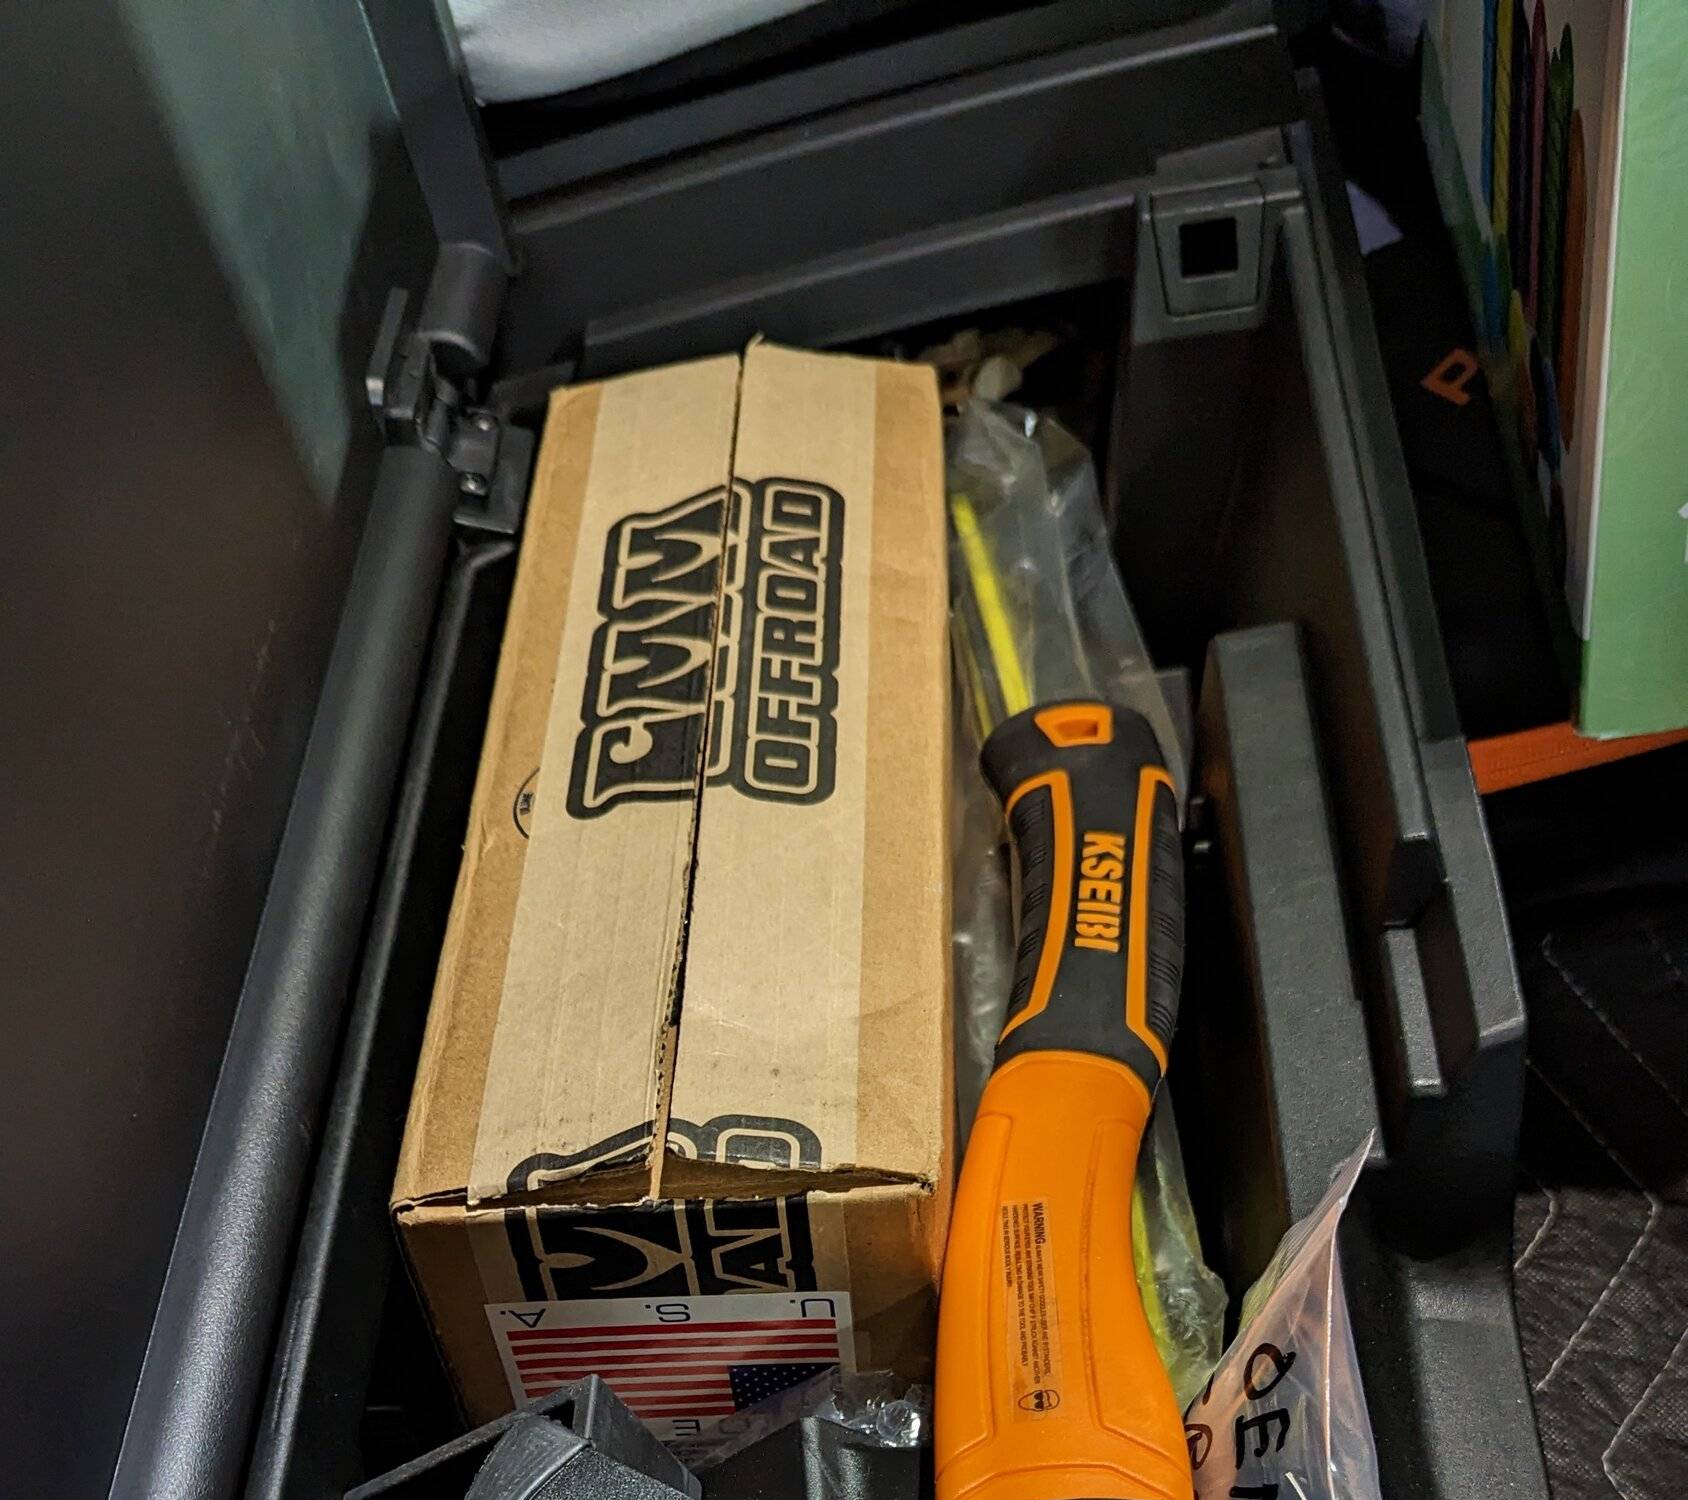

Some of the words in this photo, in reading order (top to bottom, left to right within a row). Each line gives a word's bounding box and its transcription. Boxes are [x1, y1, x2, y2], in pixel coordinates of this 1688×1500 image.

[743, 479, 836, 798] OFFROAD
[1074, 830, 1127, 953] KSEIBI
[1032, 1202, 1046, 1245] WARNING
